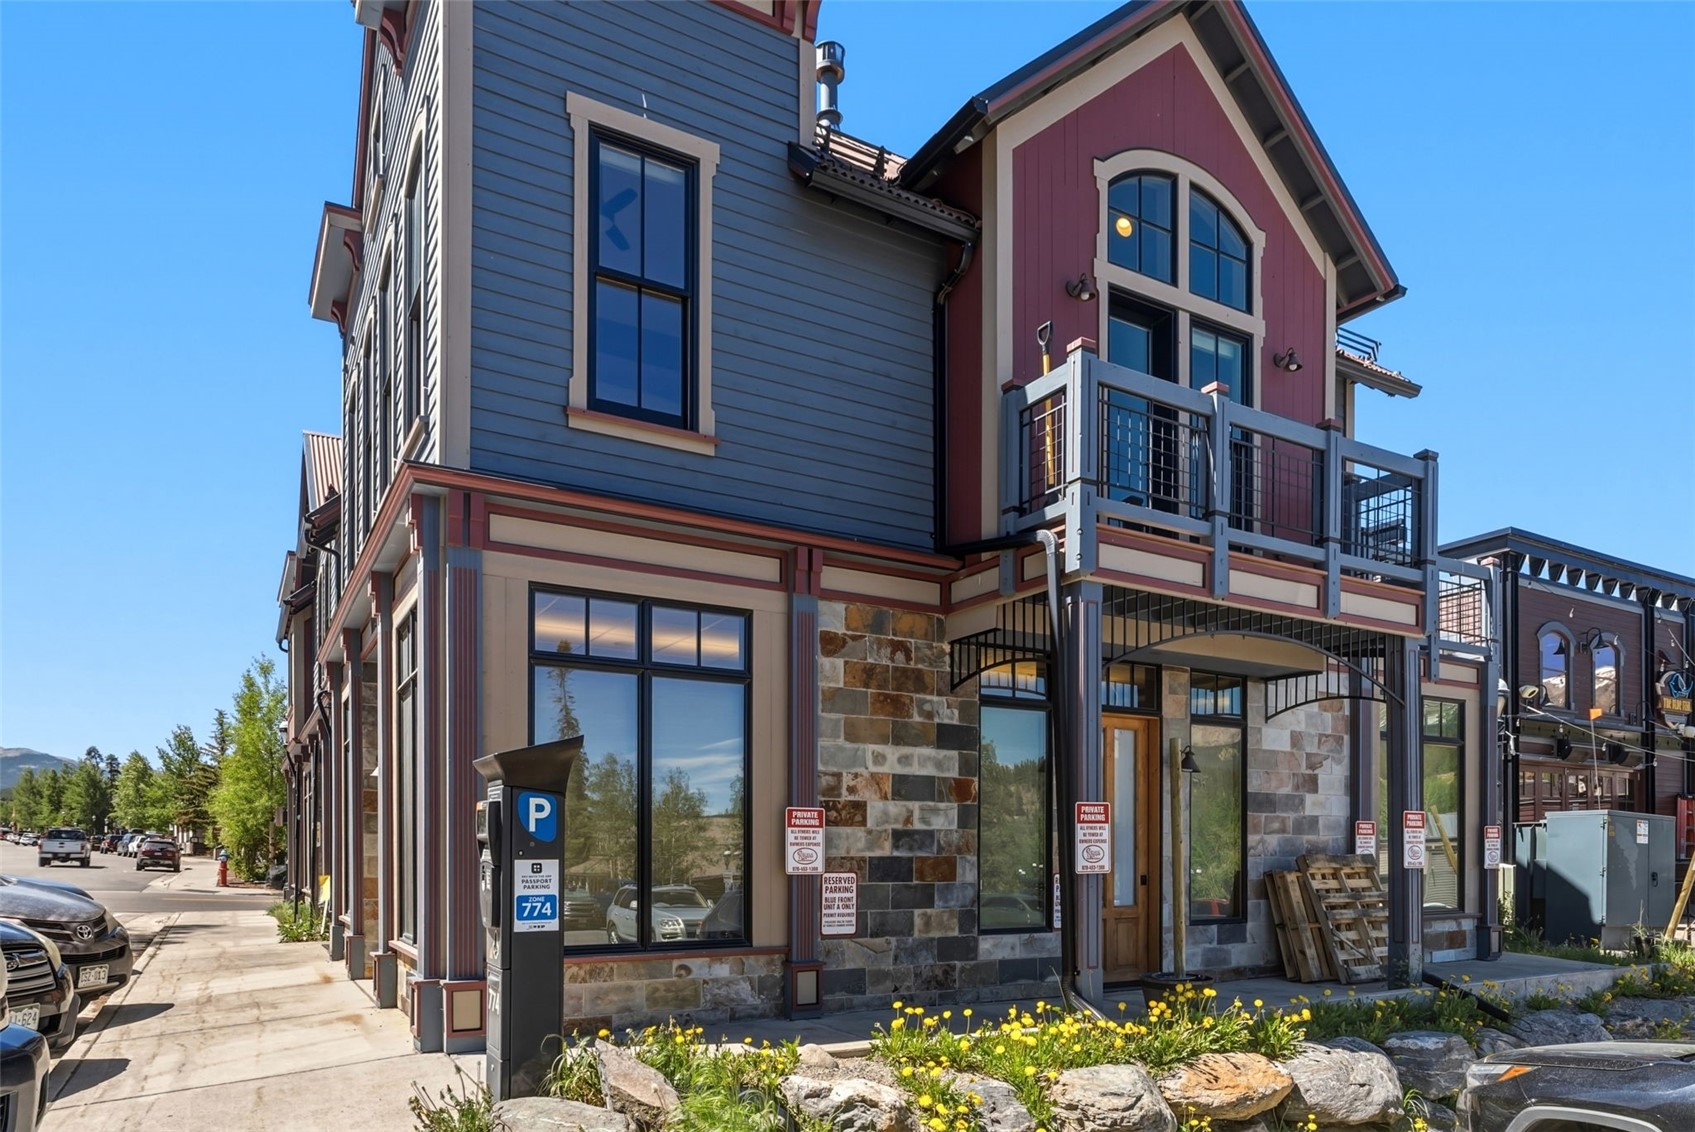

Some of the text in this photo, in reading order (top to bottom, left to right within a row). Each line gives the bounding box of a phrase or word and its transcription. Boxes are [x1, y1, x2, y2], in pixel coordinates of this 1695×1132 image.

[529, 798, 552, 832] P
[824, 876, 855, 884] RESERVED
[522, 902, 552, 917] 774
